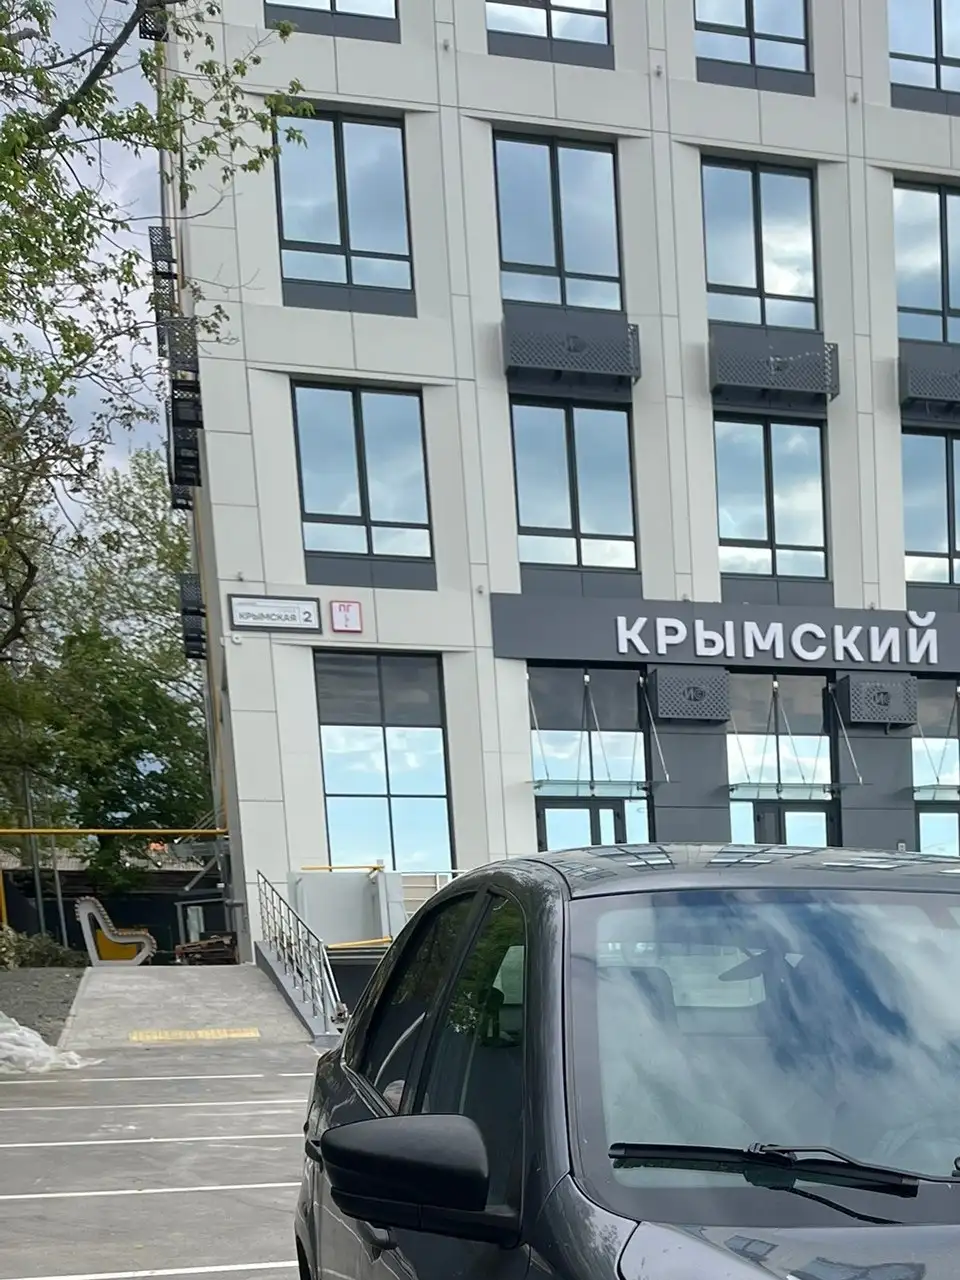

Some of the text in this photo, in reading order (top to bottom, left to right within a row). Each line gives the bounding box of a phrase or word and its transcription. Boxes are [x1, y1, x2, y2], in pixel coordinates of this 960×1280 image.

[238, 611, 297, 622] КРЫМСКАЯ
[303, 610, 313, 623] 2
[616, 610, 938, 664] КРЫМСКИЙ
